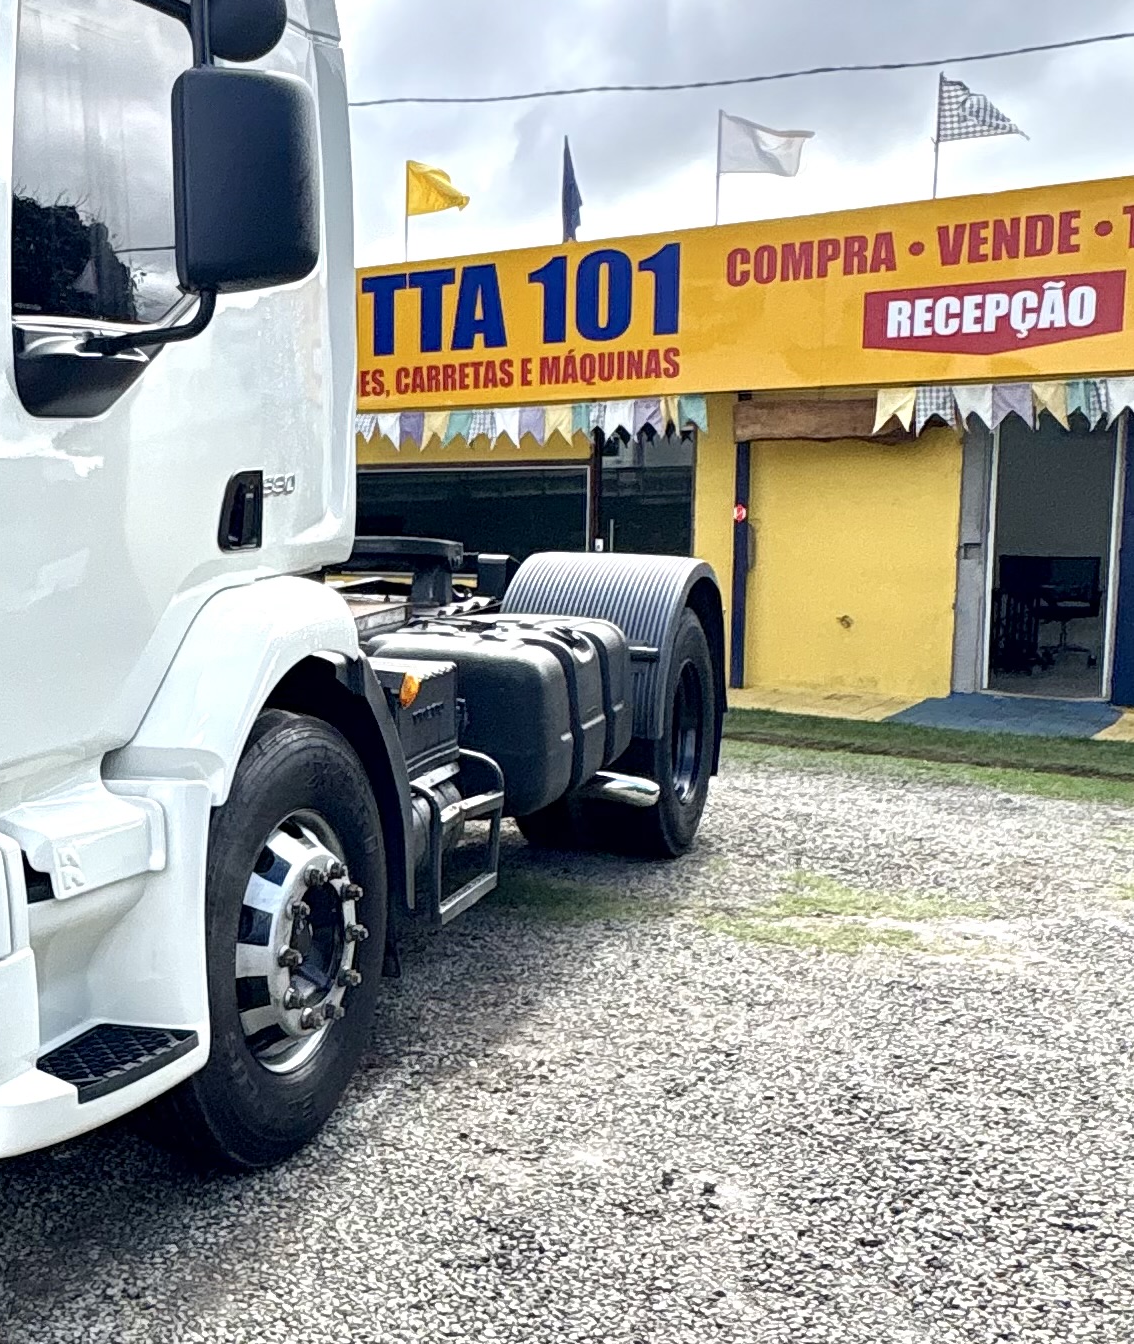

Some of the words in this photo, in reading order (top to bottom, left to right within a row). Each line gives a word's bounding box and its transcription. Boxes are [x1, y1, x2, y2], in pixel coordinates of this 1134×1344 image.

[726, 231, 897, 287] COMPRA
[937, 209, 1081, 267] VENDE
[361, 263, 508, 356] TTA
[527, 242, 681, 344] 101
[886, 280, 1097, 339] RECEPÇÃO
[395, 358, 514, 395] CARRETAS
[520, 358, 533, 387] E
[539, 347, 681, 386] MÁQUINAS
